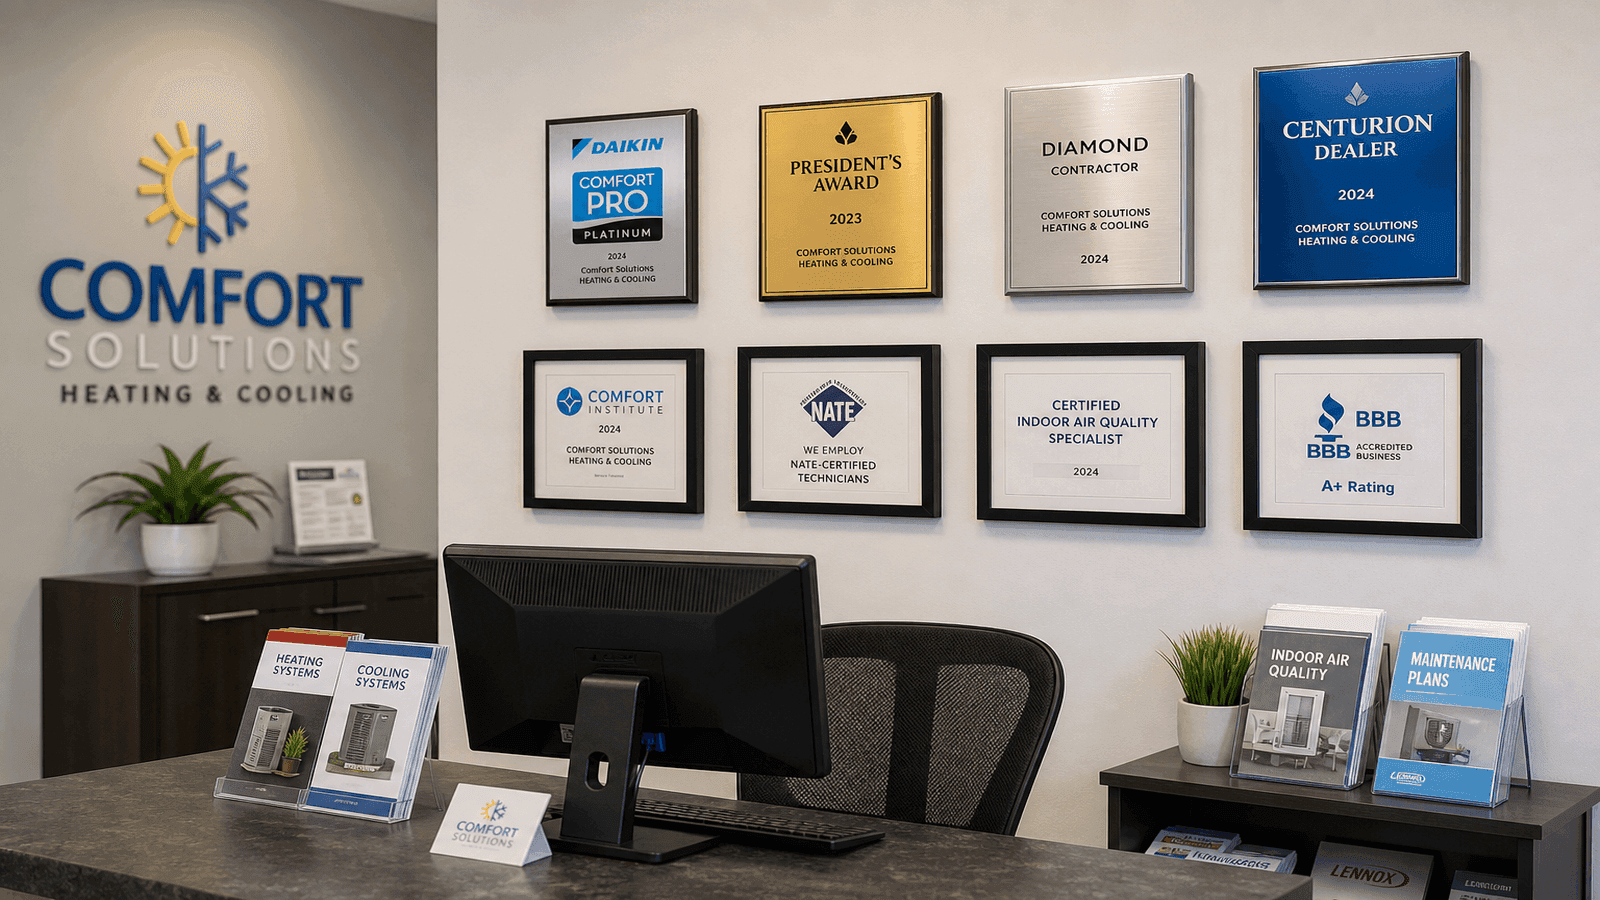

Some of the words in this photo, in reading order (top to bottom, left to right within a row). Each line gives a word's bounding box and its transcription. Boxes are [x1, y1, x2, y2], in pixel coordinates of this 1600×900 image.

[1283, 113, 1433, 139] CENTURION
[592, 138, 664, 154] DAIKIN
[1042, 137, 1148, 157] DIAMOND
[1315, 141, 1398, 160] DEALER
[790, 154, 902, 175] PRESIDENT'S
[1051, 162, 1139, 176] CONTRACTOR
[579, 173, 655, 189] COMFORT
[813, 175, 879, 192] AWARD
[1338, 188, 1375, 200] 2024
[588, 189, 648, 215] PRO
[829, 213, 862, 225] 2023
[1041, 211, 1090, 220] COMFORT
[1093, 208, 1151, 218] SOLUTIONS
[1042, 222, 1087, 232] HEATING
[1090, 222, 1097, 231] &
[1100, 220, 1149, 230] COOLING
[1295, 223, 1350, 233] COMFORT
[1354, 220, 1418, 231] SOLUTIONS
[584, 228, 651, 239] PLATINUM
[1299, 236, 1347, 246] HEATING
[1350, 236, 1358, 244] &
[1362, 234, 1415, 244] COOLING
[796, 248, 841, 257] COMFORT
[844, 246, 896, 255] SOLUTIONS
[799, 259, 838, 268] HEATING
[850, 258, 893, 266] COOLING
[1081, 254, 1109, 264] 2024
[581, 266, 614, 274] Comfort
[616, 265, 654, 273] Solutions
[40, 258, 364, 329] COMFORT
[45, 331, 362, 373] SOLUTIONS
[61, 384, 192, 403] HEATING
[206, 385, 223, 403] &
[237, 385, 355, 403] COOLING
[588, 390, 664, 403] COMFORT
[589, 406, 663, 414] INSTITUTE
[811, 401, 855, 422] NATE
[1052, 400, 1121, 411] CERTIFIED
[1017, 417, 1069, 427] INDOOR
[1074, 417, 1095, 427] AIR
[1100, 417, 1158, 428] QUALITY
[1356, 411, 1401, 427] BBB
[599, 425, 621, 434] 2024
[1049, 433, 1123, 444] SPECIALIST
[566, 446, 605, 454] COMFORT
[608, 447, 654, 455] SOLUTIONS
[803, 446, 819, 454] WE
[823, 446, 864, 455] EMPLOY
[1308, 444, 1351, 459] BBB
[614, 458, 652, 466] COOLING
[791, 460, 876, 470] NATE-CERTIFIED
[798, 474, 870, 483] TECHNICIANS
[1074, 468, 1099, 476] 2024
[1321, 480, 1342, 492] A+
[1348, 481, 1395, 495] Rating
[276, 654, 324, 667] HEATING
[1271, 648, 1323, 664] INDOOR
[1327, 653, 1350, 667] AIR
[1411, 652, 1497, 672] MAINTENANCE
[273, 666, 320, 679] SYSTEMS
[358, 665, 409, 679] COOLING
[1269, 664, 1328, 681] QUALITY
[355, 677, 406, 691] SYSTEMS
[1407, 671, 1449, 687] PLANS
[457, 821, 519, 838] COMFORT
[452, 832, 514, 848] SOLUTIONS
[1330, 864, 1397, 885] LENNOX
